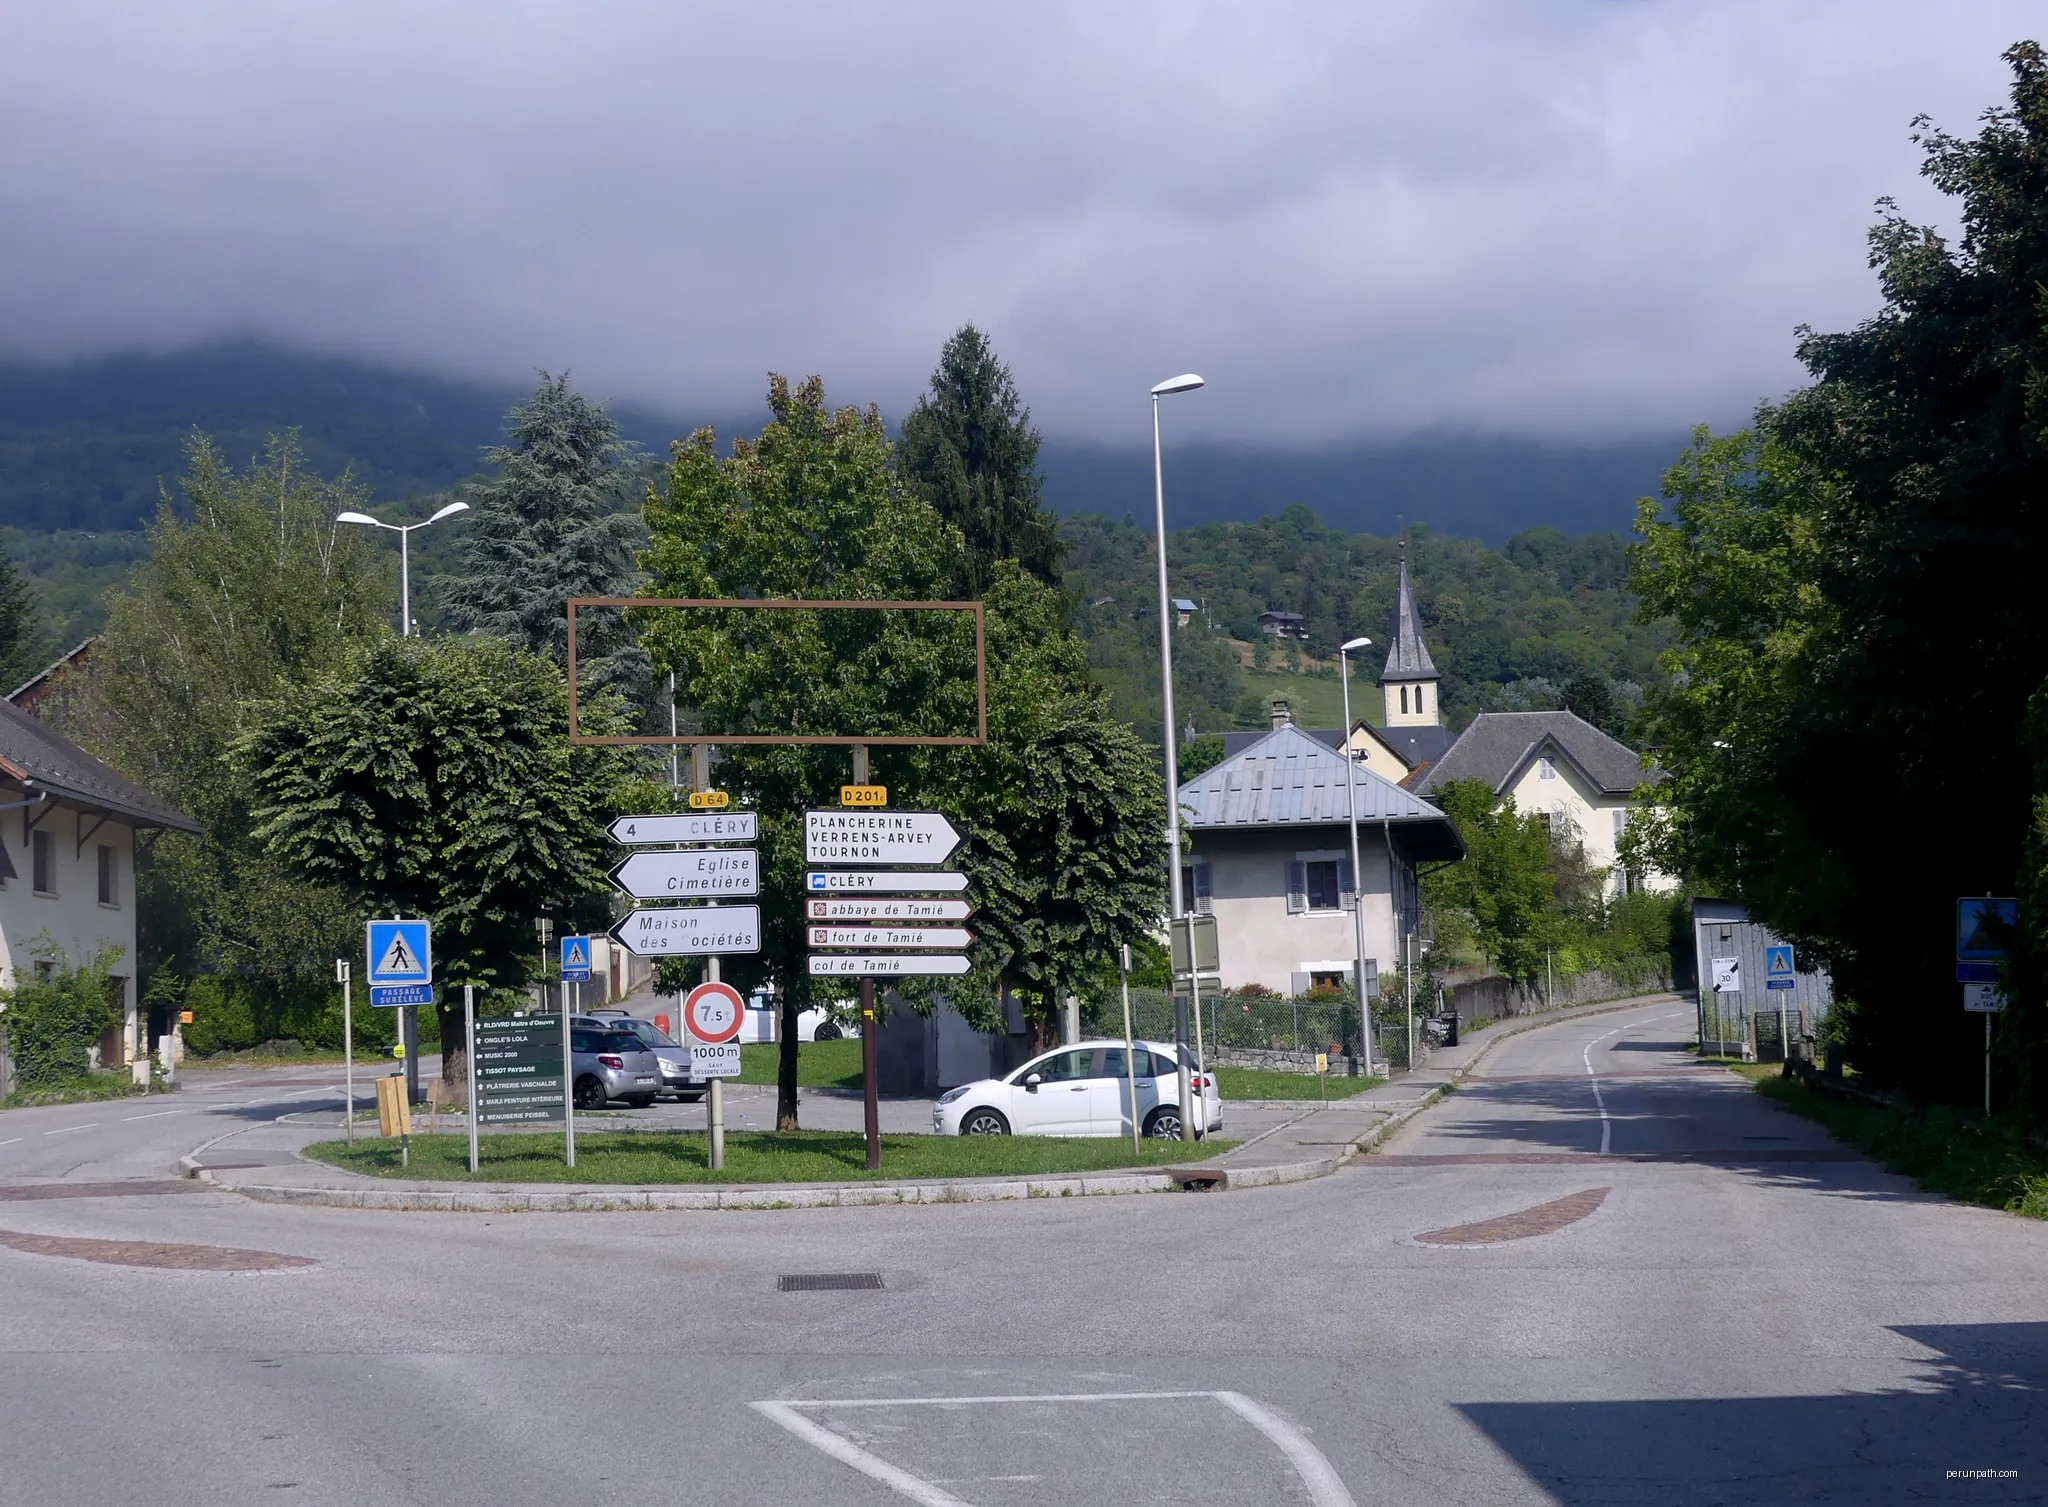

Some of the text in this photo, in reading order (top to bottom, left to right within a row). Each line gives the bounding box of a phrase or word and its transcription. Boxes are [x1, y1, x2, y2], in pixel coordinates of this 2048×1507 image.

[695, 794, 724, 805] D 64
[844, 791, 852, 801] D
[626, 817, 749, 836] 4 CLÉRY
[810, 817, 912, 828] PLANCHERINE
[811, 832, 933, 844] VERRENS-ARVEY
[811, 846, 880, 857] TOURNON
[697, 857, 749, 874] Eglise
[667, 875, 750, 890] Cimetière
[830, 873, 875, 887] CLÉRY
[831, 903, 943, 916] abbaye de Tamié
[639, 916, 698, 930] Maison
[640, 933, 752, 948] des ociétés
[832, 931, 923, 943] fort de Tamié
[814, 958, 900, 970] col de Tamié
[1721, 974, 1731, 982] 30
[382, 987, 420, 996] PASSAGE
[380, 994, 424, 1004] SURÉLEVÉ
[693, 1047, 738, 1058] 1000 m
[520, 1080, 557, 1088] VASCHALDE
[487, 1112, 523, 1120] MENUISERIE
